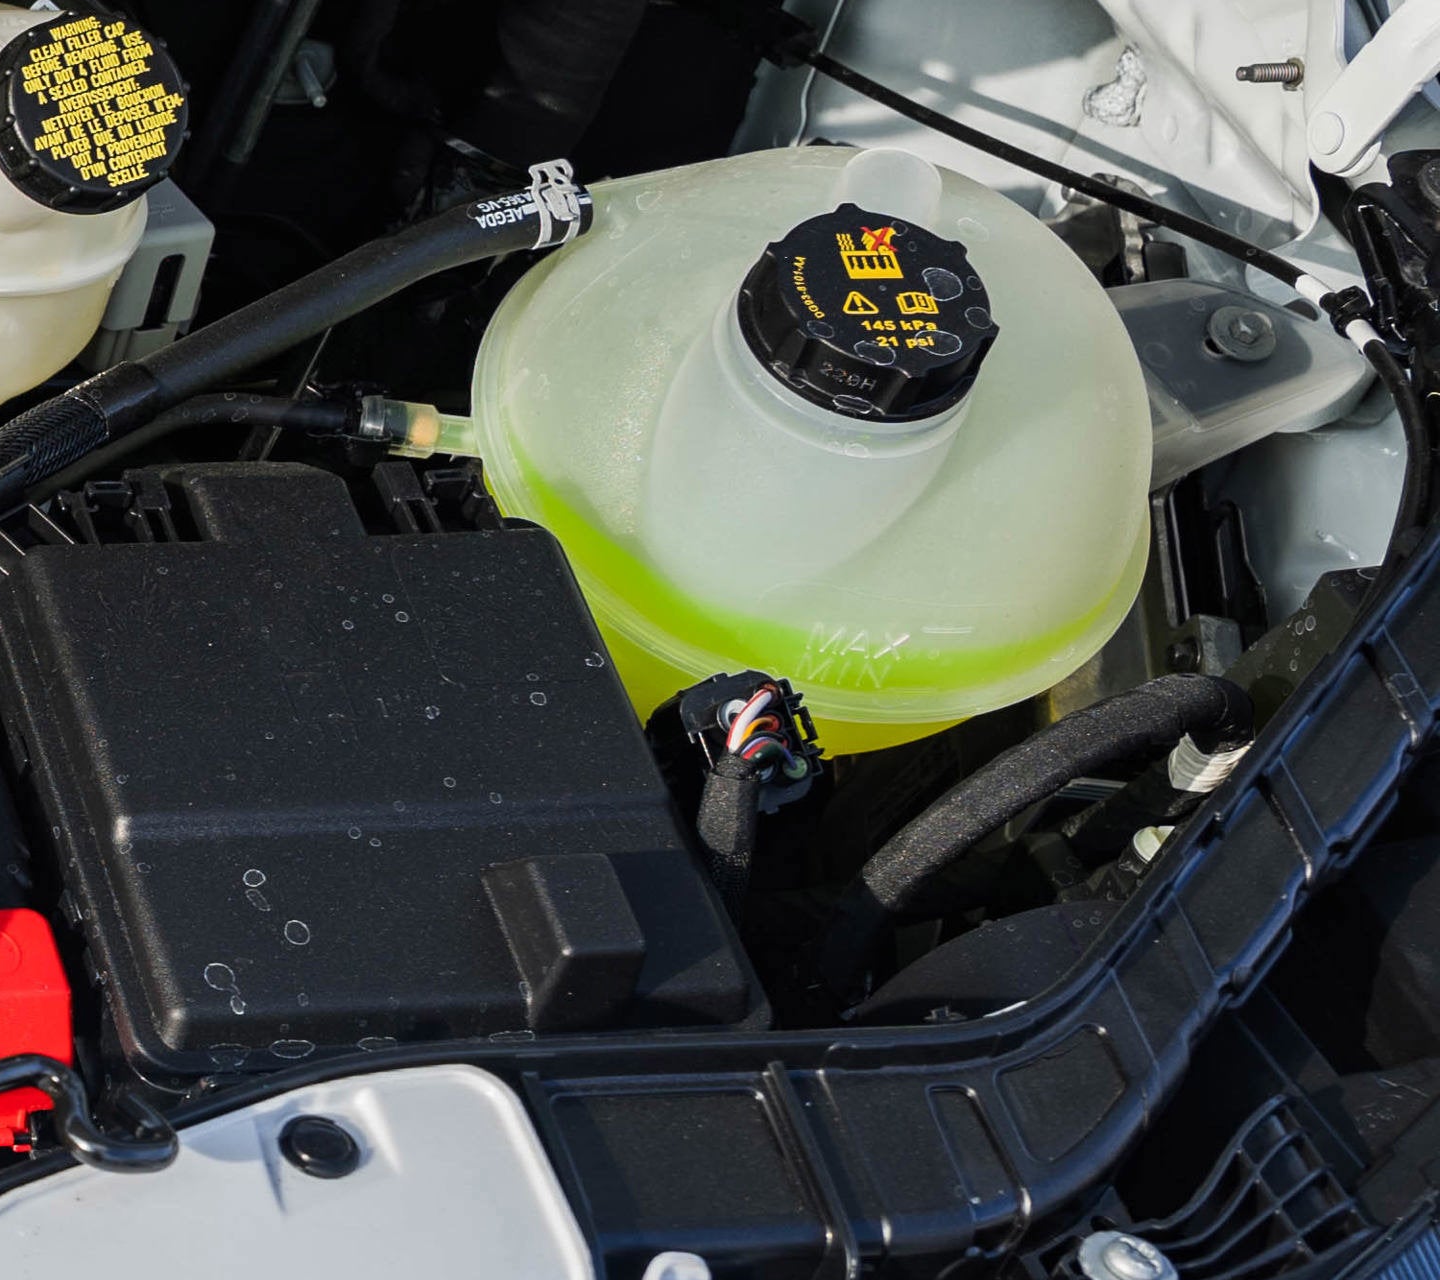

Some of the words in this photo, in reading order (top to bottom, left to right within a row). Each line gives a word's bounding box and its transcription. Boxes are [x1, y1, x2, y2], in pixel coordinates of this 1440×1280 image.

[29, 41, 65, 62] CLEAN
[66, 29, 102, 51] FILLER
[104, 21, 125, 39] CAP
[49, 16, 101, 41] WARNING:
[21, 56, 63, 80] BEFORE
[64, 39, 121, 66] REMOVING.
[121, 30, 144, 48] USE
[23, 74, 51, 94] ONLY
[53, 67, 75, 84] DOT
[79, 64, 87, 76] 4
[88, 53, 120, 73] FLUID
[121, 42, 153, 63] FROM
[38, 91, 47, 105] A
[48, 78, 88, 101] SEALED
[90, 59, 150, 87] CONTAINER.
[58, 77, 141, 114] AVERTISSEMENT:
[41, 106, 95, 133] NETTOYER
[96, 101, 111, 115] LE
[116, 83, 166, 110] BOUCHON
[34, 129, 67, 151] AVANT
[69, 123, 86, 139] DE
[87, 118, 103, 133] LE
[50, 137, 91, 160] PLOYER
[93, 129, 117, 146] QUE
[117, 123, 134, 139] DU
[135, 109, 177, 133] LIQUIDE
[70, 151, 92, 169] DOT
[96, 147, 105, 160] 4
[106, 127, 165, 157] PROVENANT
[80, 161, 107, 180] D'UN
[108, 141, 166, 171] CONTENANT
[475, 208, 524, 229] AEGDA
[860, 319, 897, 331] 145
[901, 320, 937, 331] kPa
[875, 336, 899, 348] 21
[904, 335, 936, 349] psi
[805, 620, 911, 661] MAX
[794, 652, 892, 688] MIN
